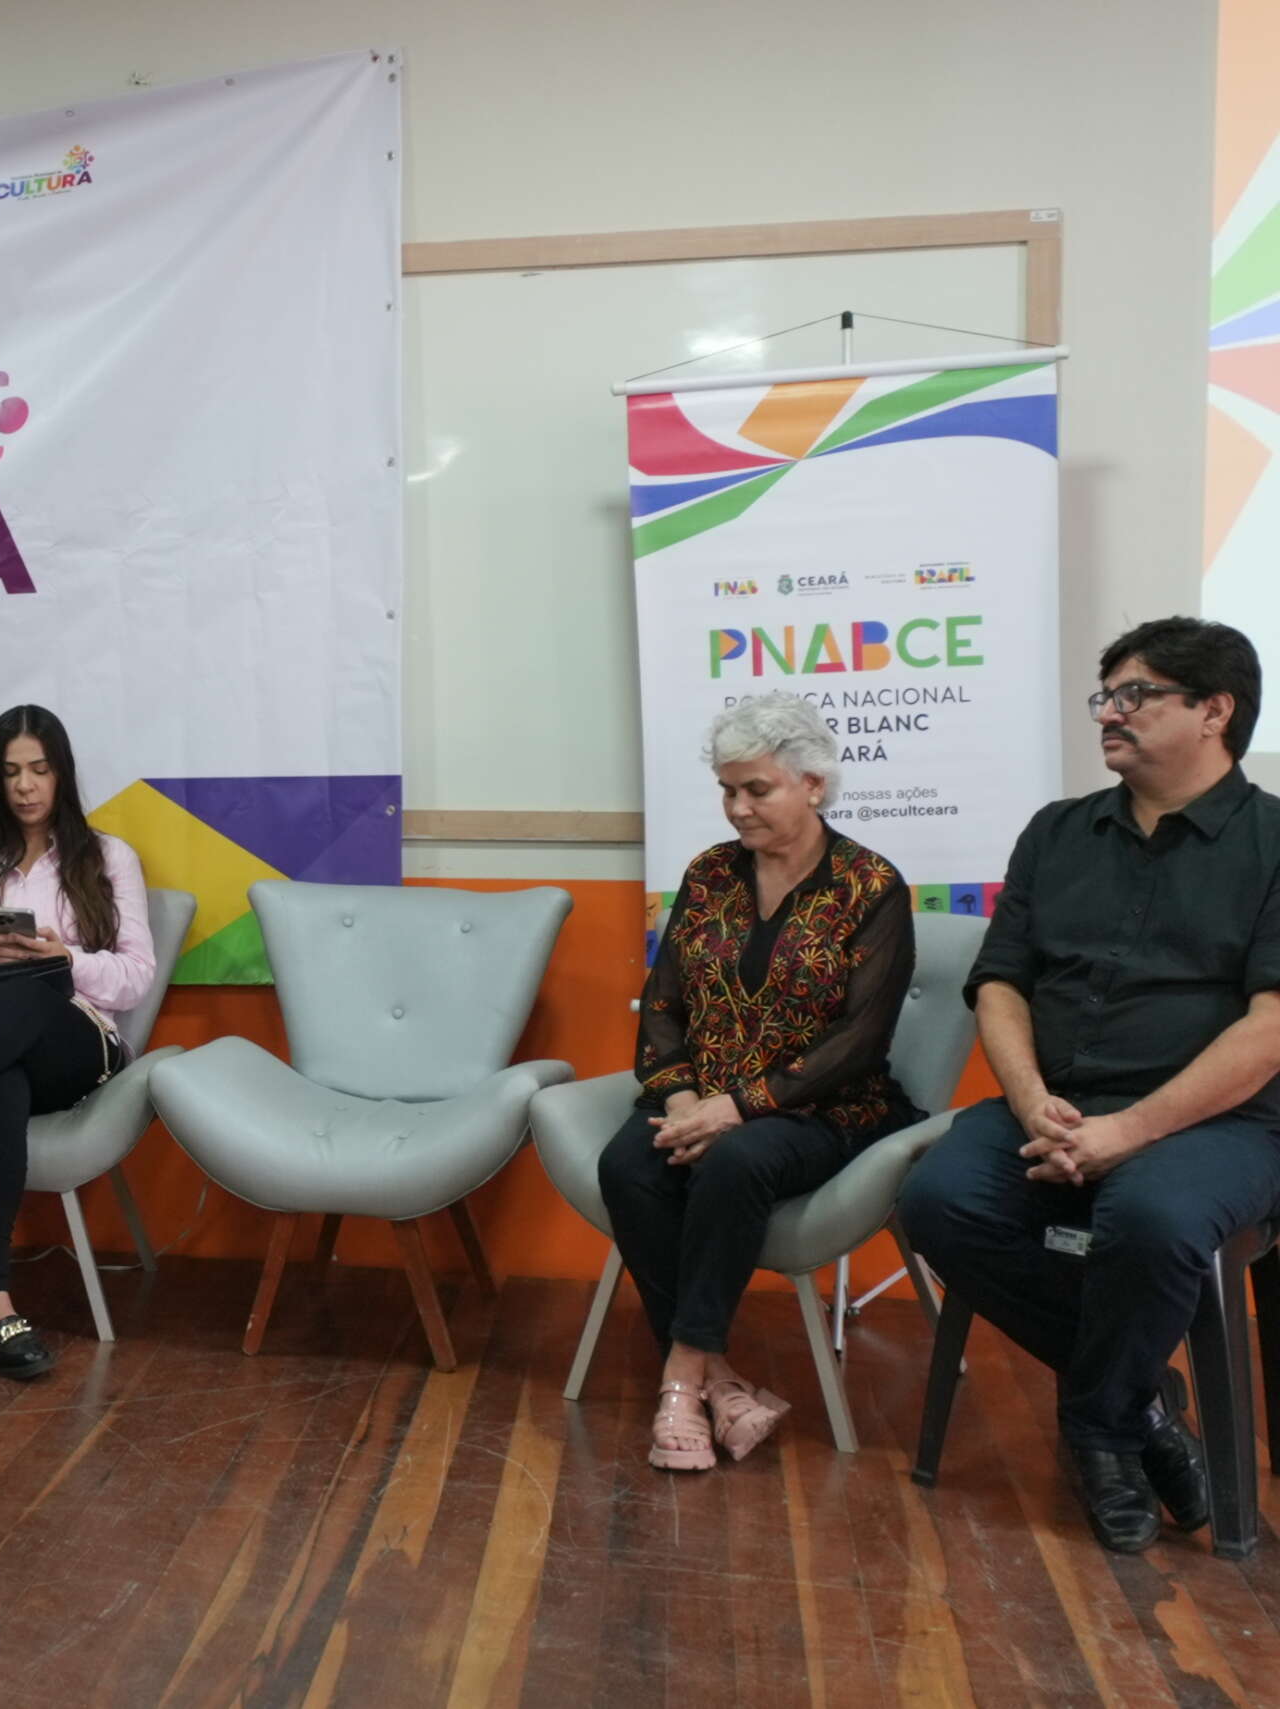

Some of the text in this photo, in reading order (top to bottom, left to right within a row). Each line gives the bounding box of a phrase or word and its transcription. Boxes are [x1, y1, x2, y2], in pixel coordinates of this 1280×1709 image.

[797, 570, 849, 586] CEARÁ
[709, 614, 984, 679] PNABCE
[843, 685, 972, 708] NACIONAL
[847, 713, 929, 735] BLANC
[840, 739, 888, 763] ARÁ
[842, 786, 939, 801] nossas ações
[822, 804, 959, 821] eara @secultceara
